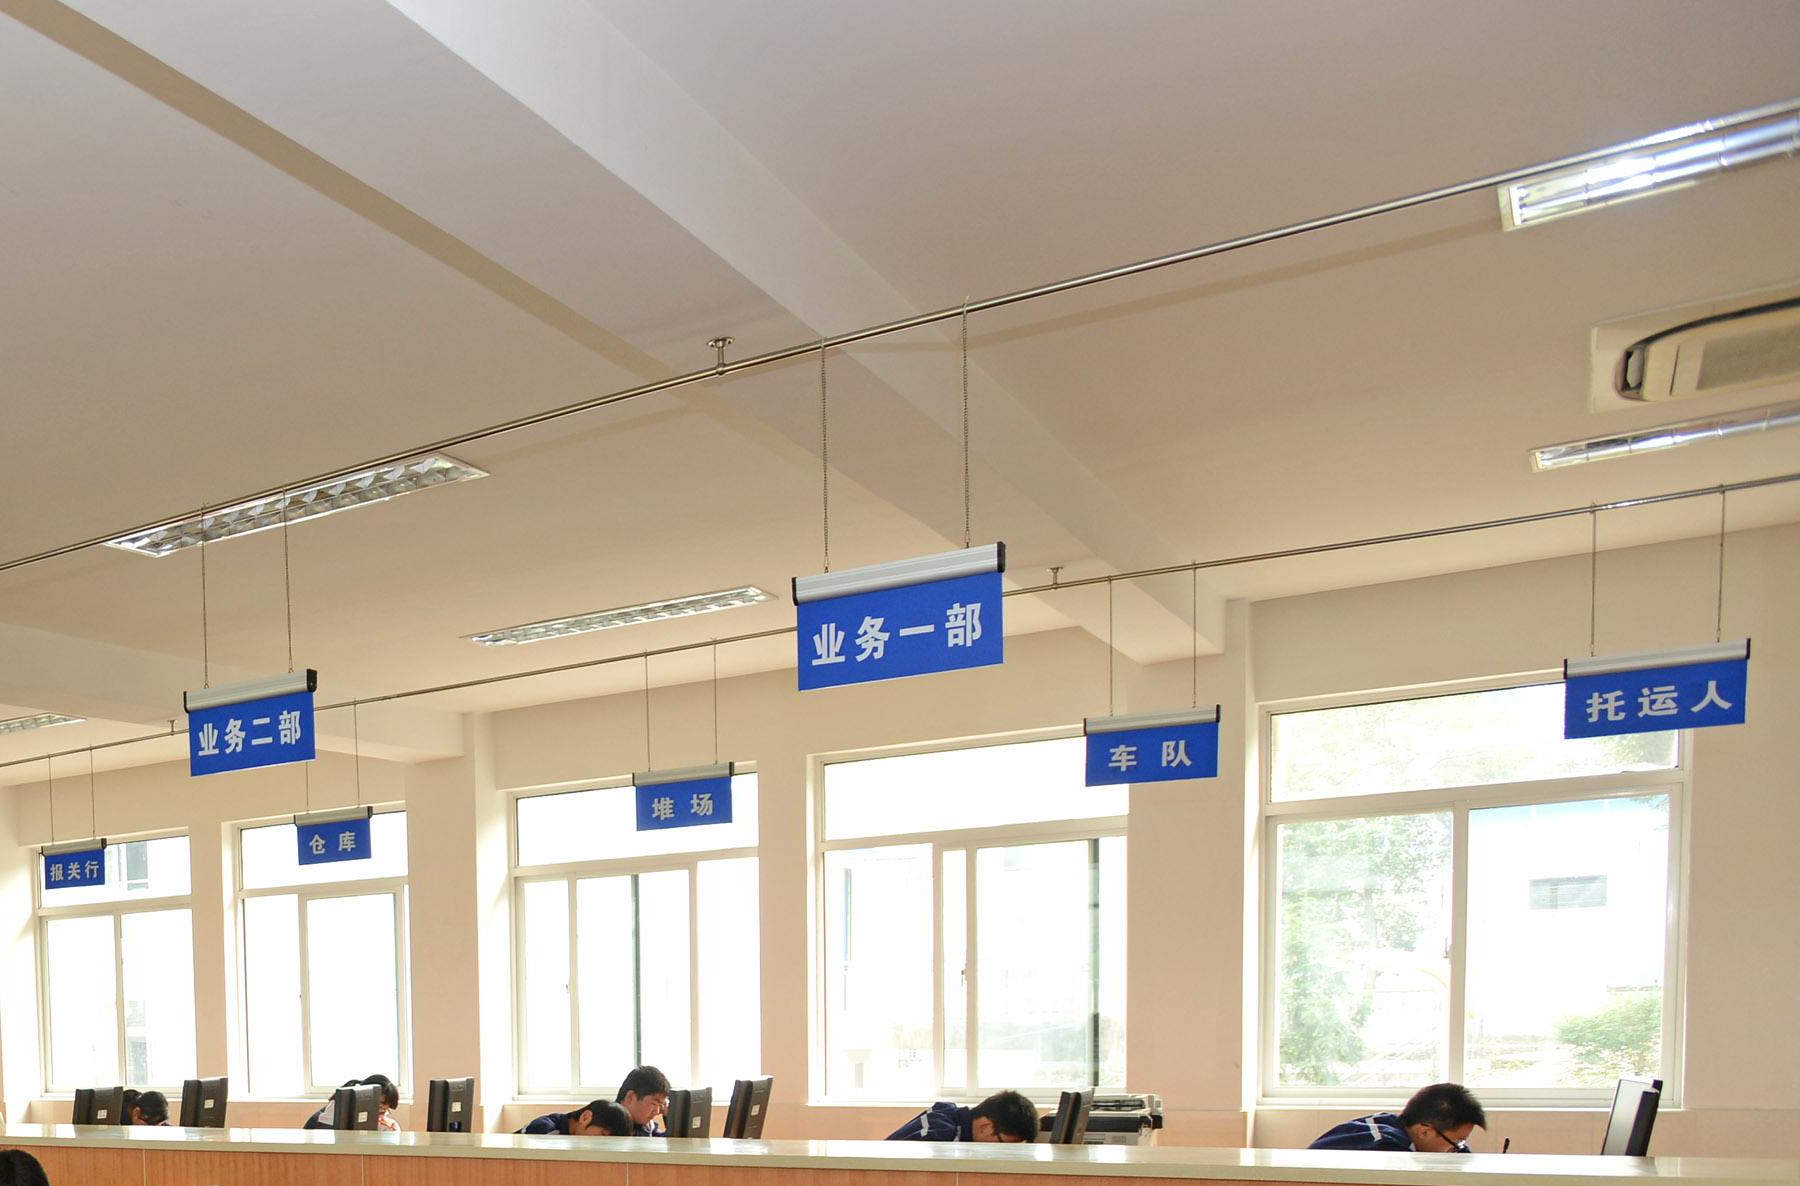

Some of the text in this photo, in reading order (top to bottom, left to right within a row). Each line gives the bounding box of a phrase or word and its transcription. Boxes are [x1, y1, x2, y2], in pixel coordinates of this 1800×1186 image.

[811, 602, 983, 667] 业务一部
[1587, 679, 1731, 723] 托运人
[198, 709, 302, 757] 业务二部
[1109, 740, 1192, 771] 车队
[652, 792, 713, 821] 堆场
[309, 831, 356, 855] 仓库
[50, 859, 99, 881] 报关行
